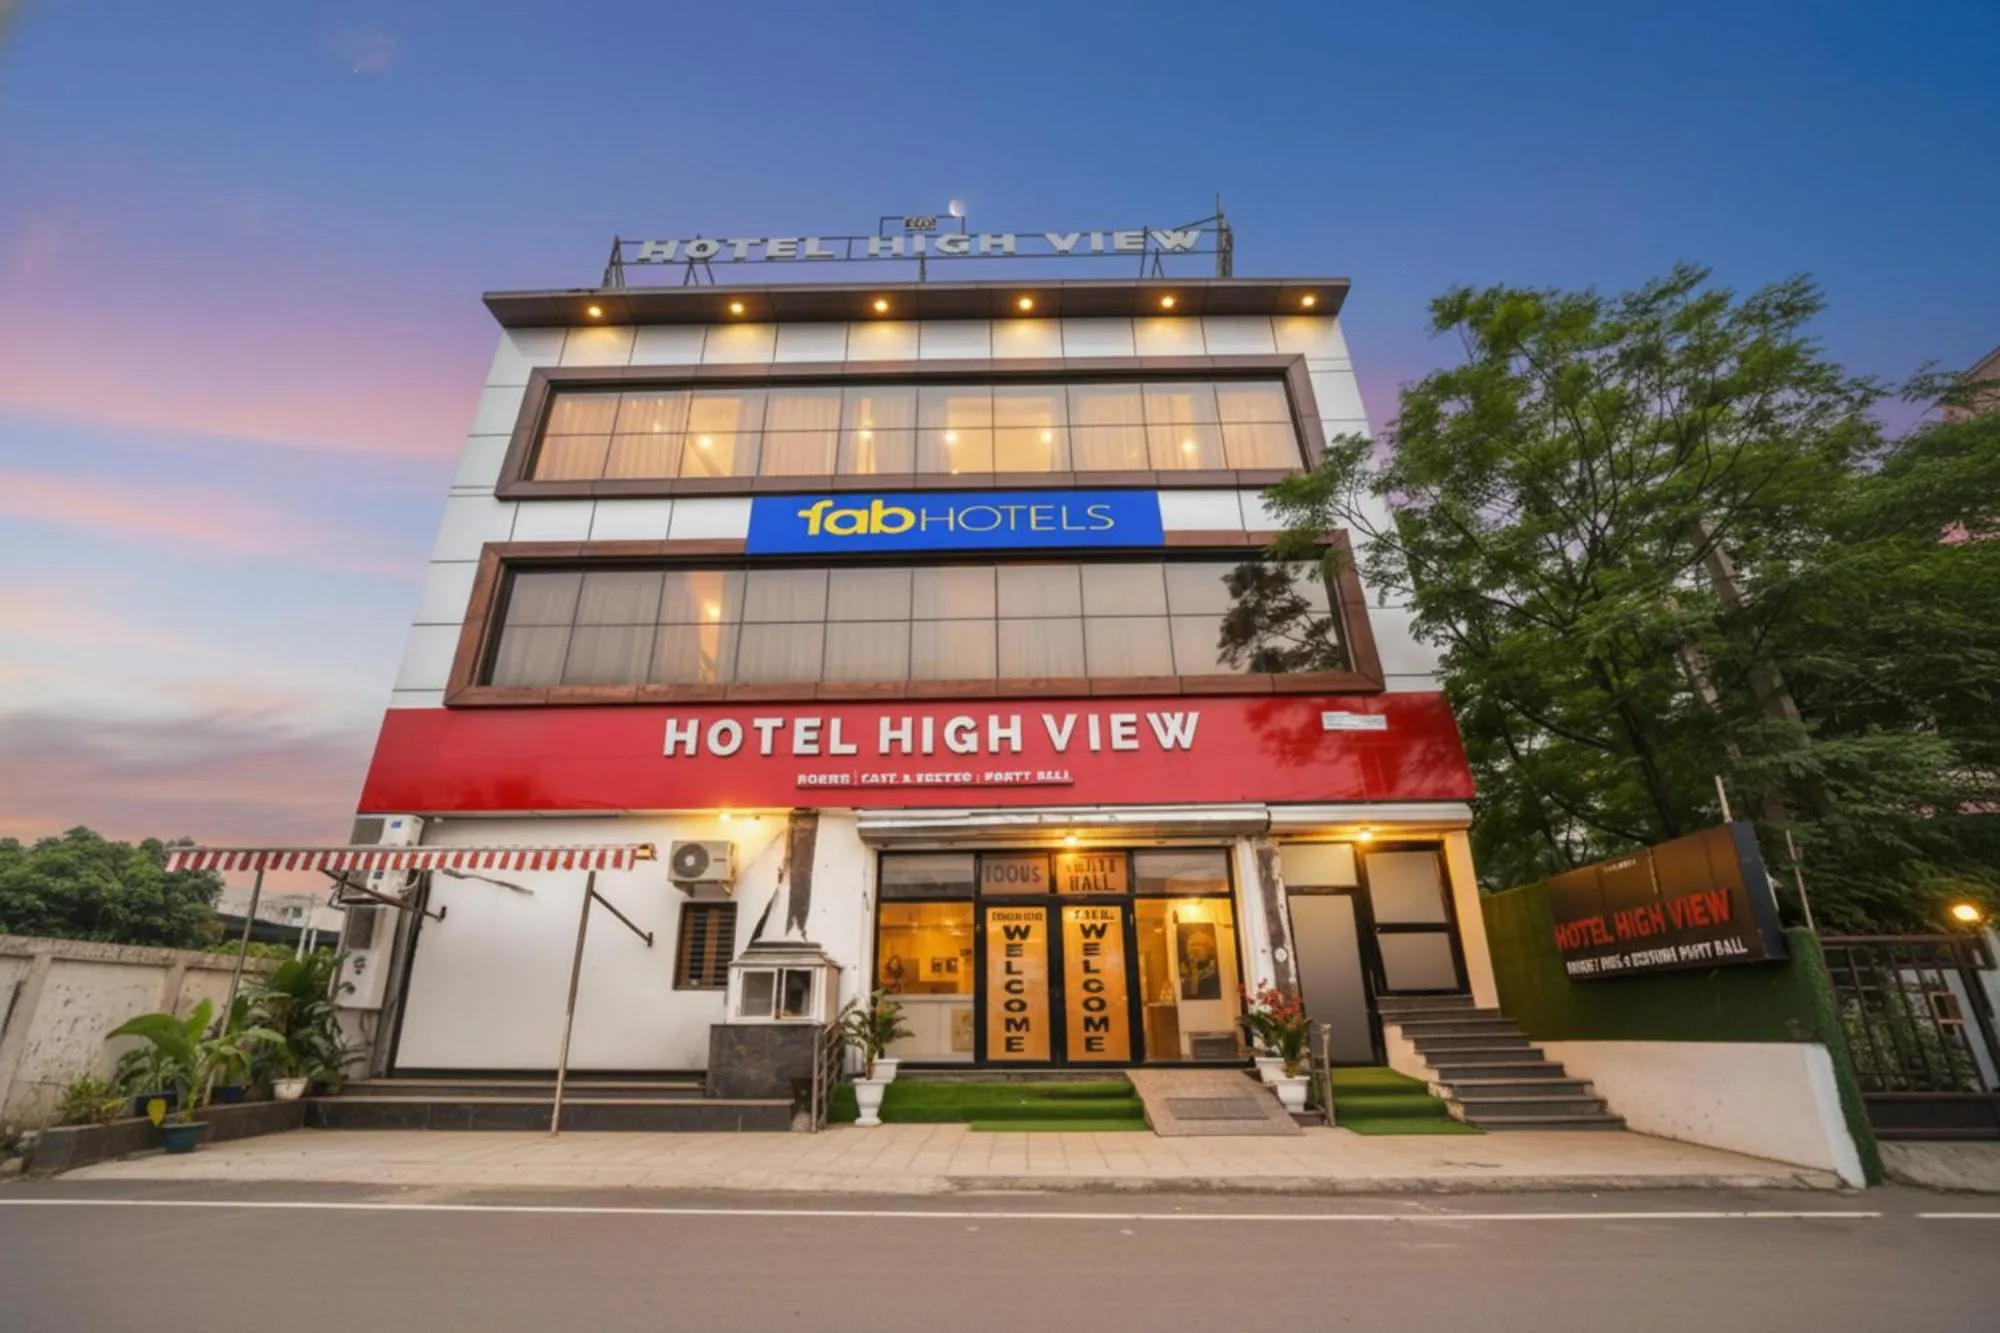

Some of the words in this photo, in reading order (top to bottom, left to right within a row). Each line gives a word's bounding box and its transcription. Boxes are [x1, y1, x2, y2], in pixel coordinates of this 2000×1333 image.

[636, 236, 835, 262] HOTEL
[867, 233, 1015, 257] HIGH
[1045, 230, 1201, 254] VIEW
[663, 716, 858, 757] HOTEL
[879, 714, 1022, 755] HIGH
[1042, 711, 1199, 752] VIEW
[1555, 915, 1615, 951] HOTEL
[1666, 888, 1731, 930] VIEW
[1002, 925, 1031, 1052] WELCOME
[1080, 923, 1110, 1052] WELCOME
